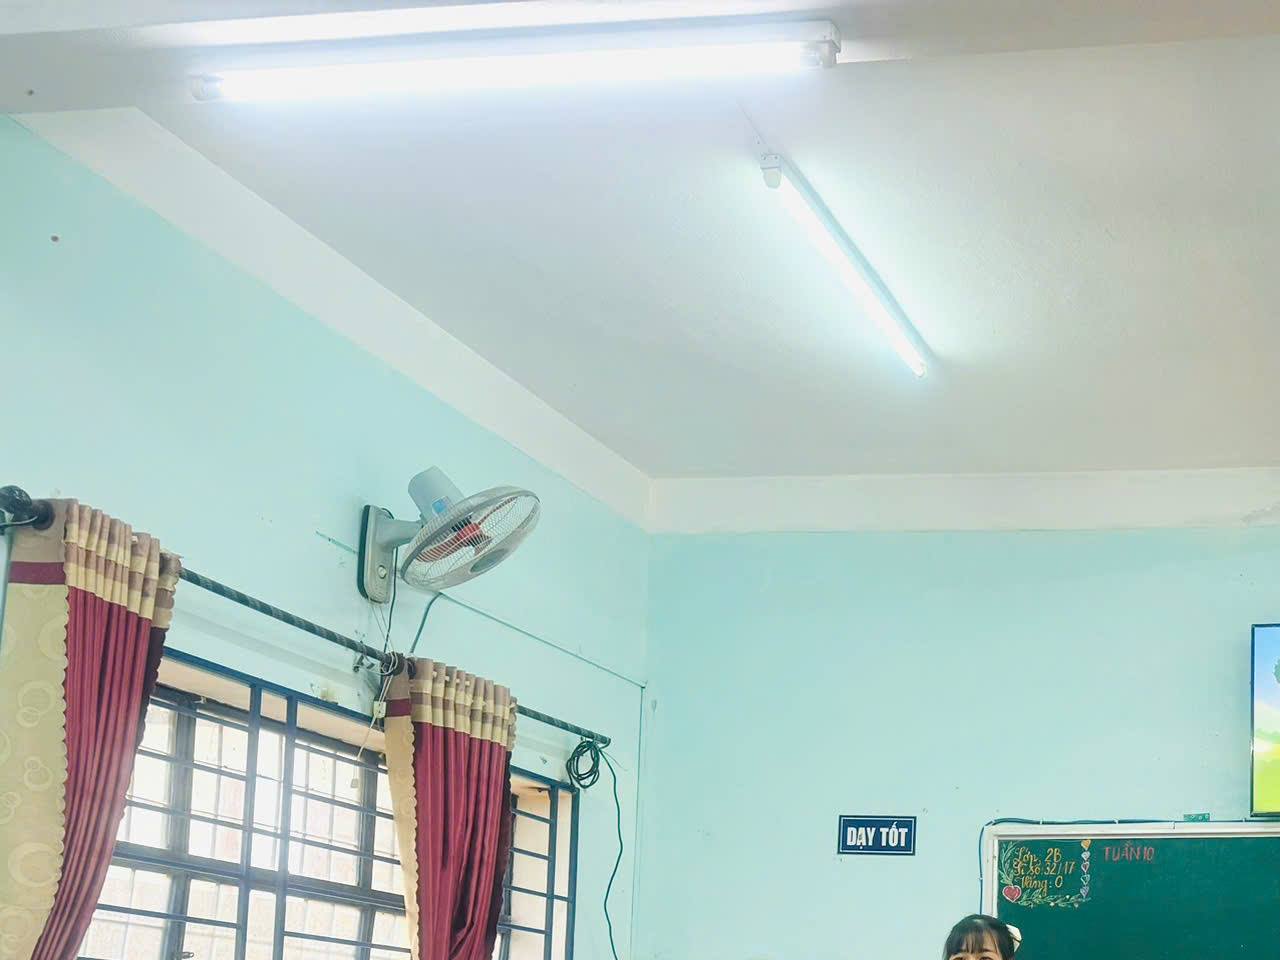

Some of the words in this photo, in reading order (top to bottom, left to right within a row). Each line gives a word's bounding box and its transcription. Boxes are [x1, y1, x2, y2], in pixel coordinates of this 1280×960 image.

[846, 826, 876, 850] DẠY
[879, 820, 909, 847] TỐT
[1044, 847, 1062, 863] 2B
